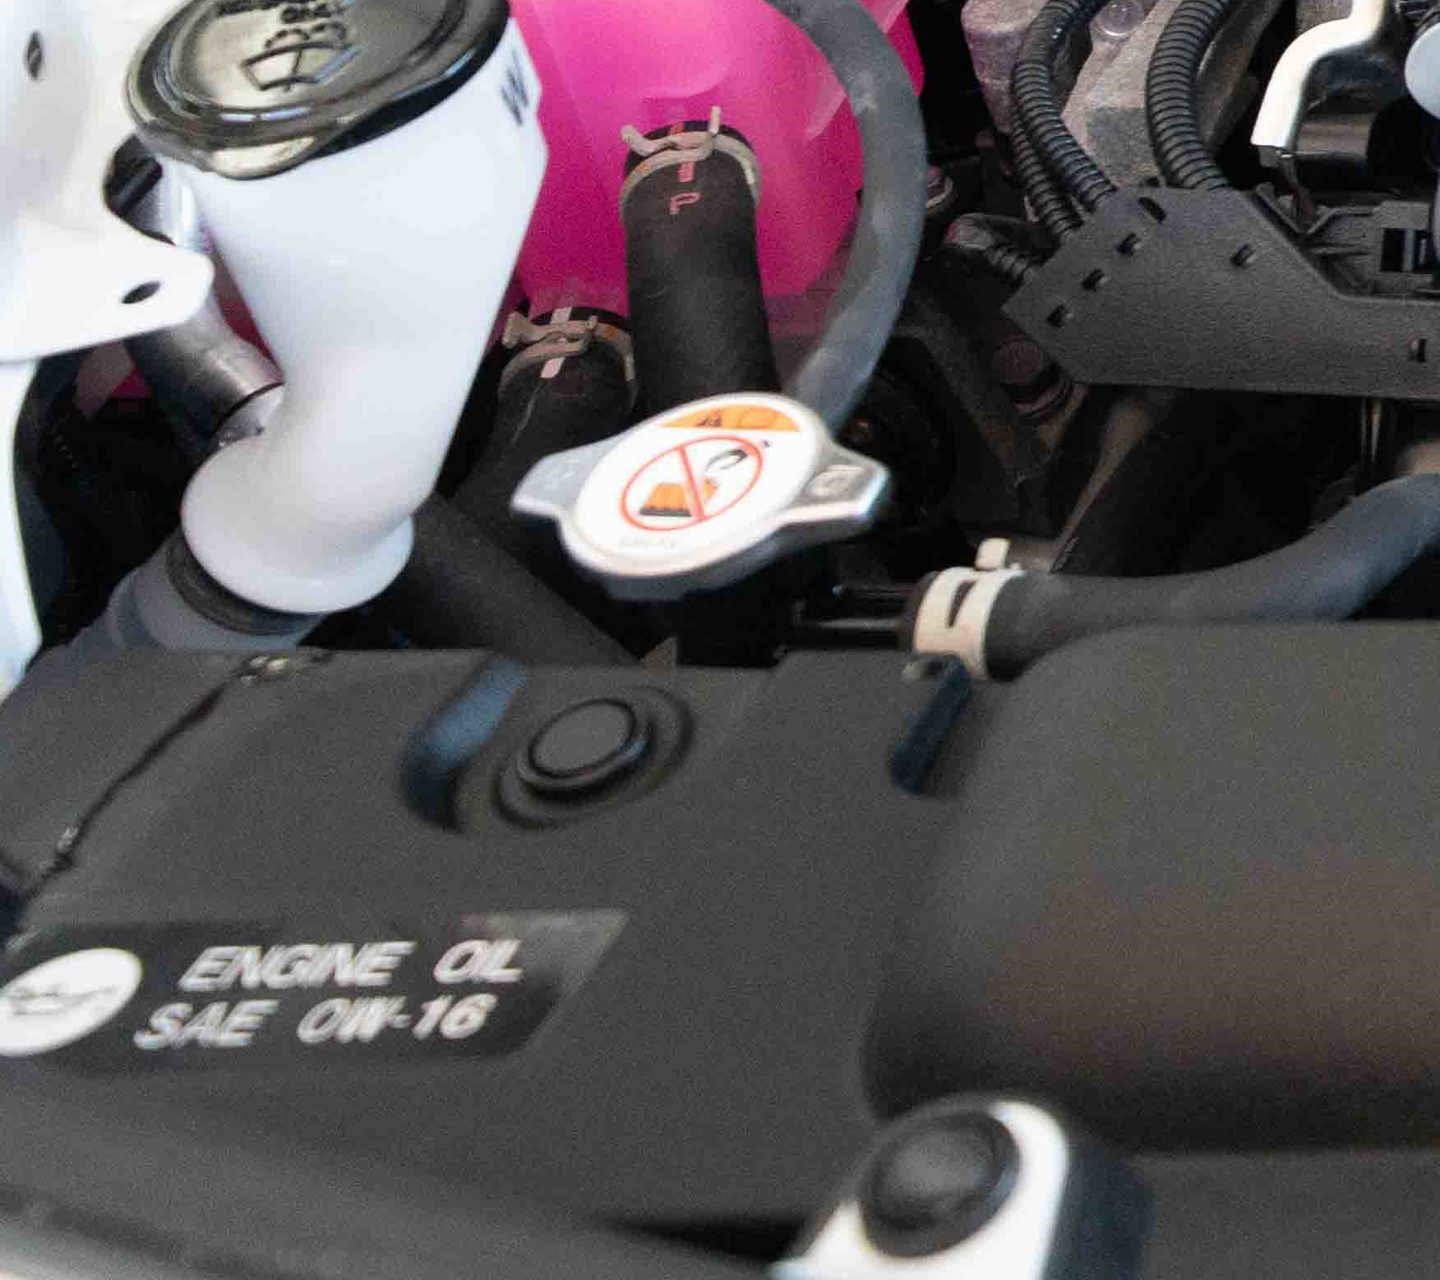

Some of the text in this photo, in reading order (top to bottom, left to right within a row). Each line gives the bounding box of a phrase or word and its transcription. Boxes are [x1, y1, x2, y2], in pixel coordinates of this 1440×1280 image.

[177, 938, 524, 993] ENGINE OIL
[133, 998, 280, 1051] SAE
